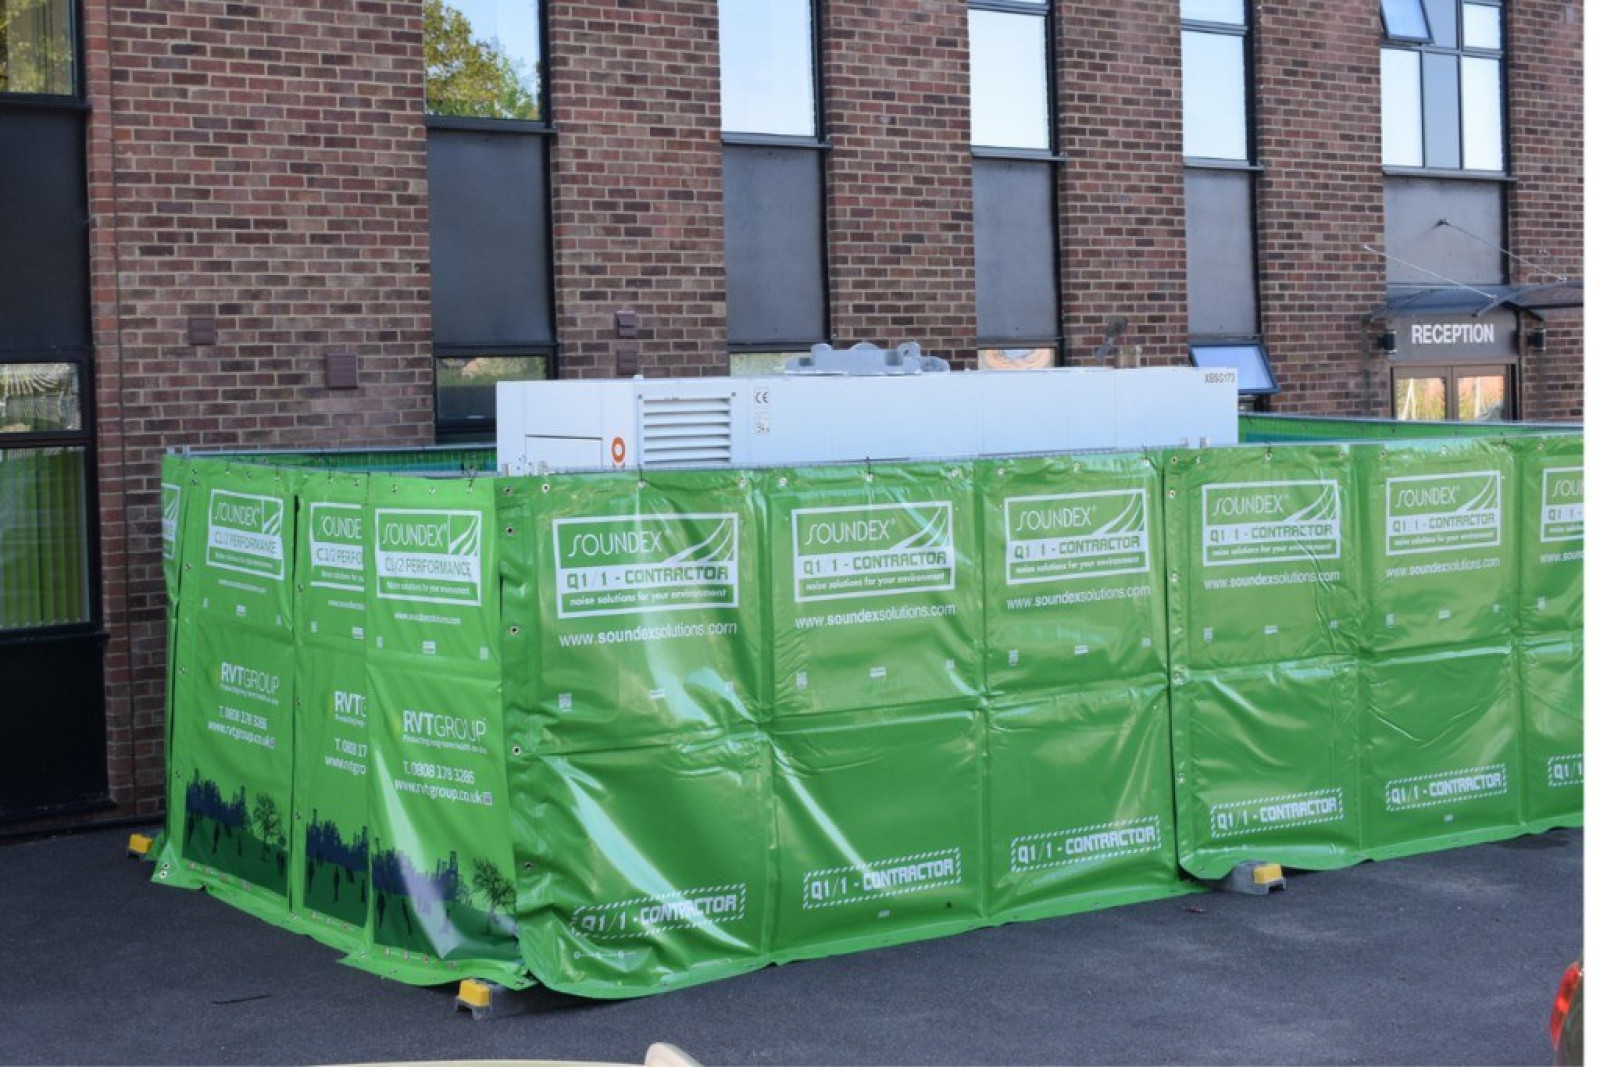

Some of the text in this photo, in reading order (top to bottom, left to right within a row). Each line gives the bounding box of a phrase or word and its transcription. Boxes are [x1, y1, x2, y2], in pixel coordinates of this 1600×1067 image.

[1411, 323, 1495, 345] RECEPTION
[1212, 494, 1285, 517] SOUNDEX
[1395, 488, 1456, 508] SOUNDEX
[320, 514, 362, 539] OUNDE
[1016, 507, 1092, 531] SOUNDEX
[1429, 513, 1495, 529] CONTRACTOR
[382, 523, 443, 548] SOUNDEX
[568, 530, 662, 557] SOUNDEX
[805, 519, 891, 546] SOUNDEX
[1060, 535, 1140, 553] CONTRACTOR
[1252, 524, 1333, 540] CONTRACTOR
[405, 558, 471, 577] PERFORMANCE
[853, 551, 946, 570] CONTRACTOR
[625, 566, 728, 584] CONTRACTOR
[1006, 585, 1151, 610] www.soundexsolutions.com
[795, 603, 955, 629] www.soundexsolutions.com
[559, 622, 737, 648] www.soundexsolutions.com
[221, 662, 279, 694] RVTGROUP
[402, 710, 487, 742] RVTGROUP
[1430, 773, 1502, 797] CONTRACTOR
[1260, 797, 1338, 823] CONTRACTOR
[1065, 825, 1156, 856] CONTRACTOR
[863, 859, 954, 890] CONTRACTOR
[640, 894, 738, 925] CONTRACTOR
